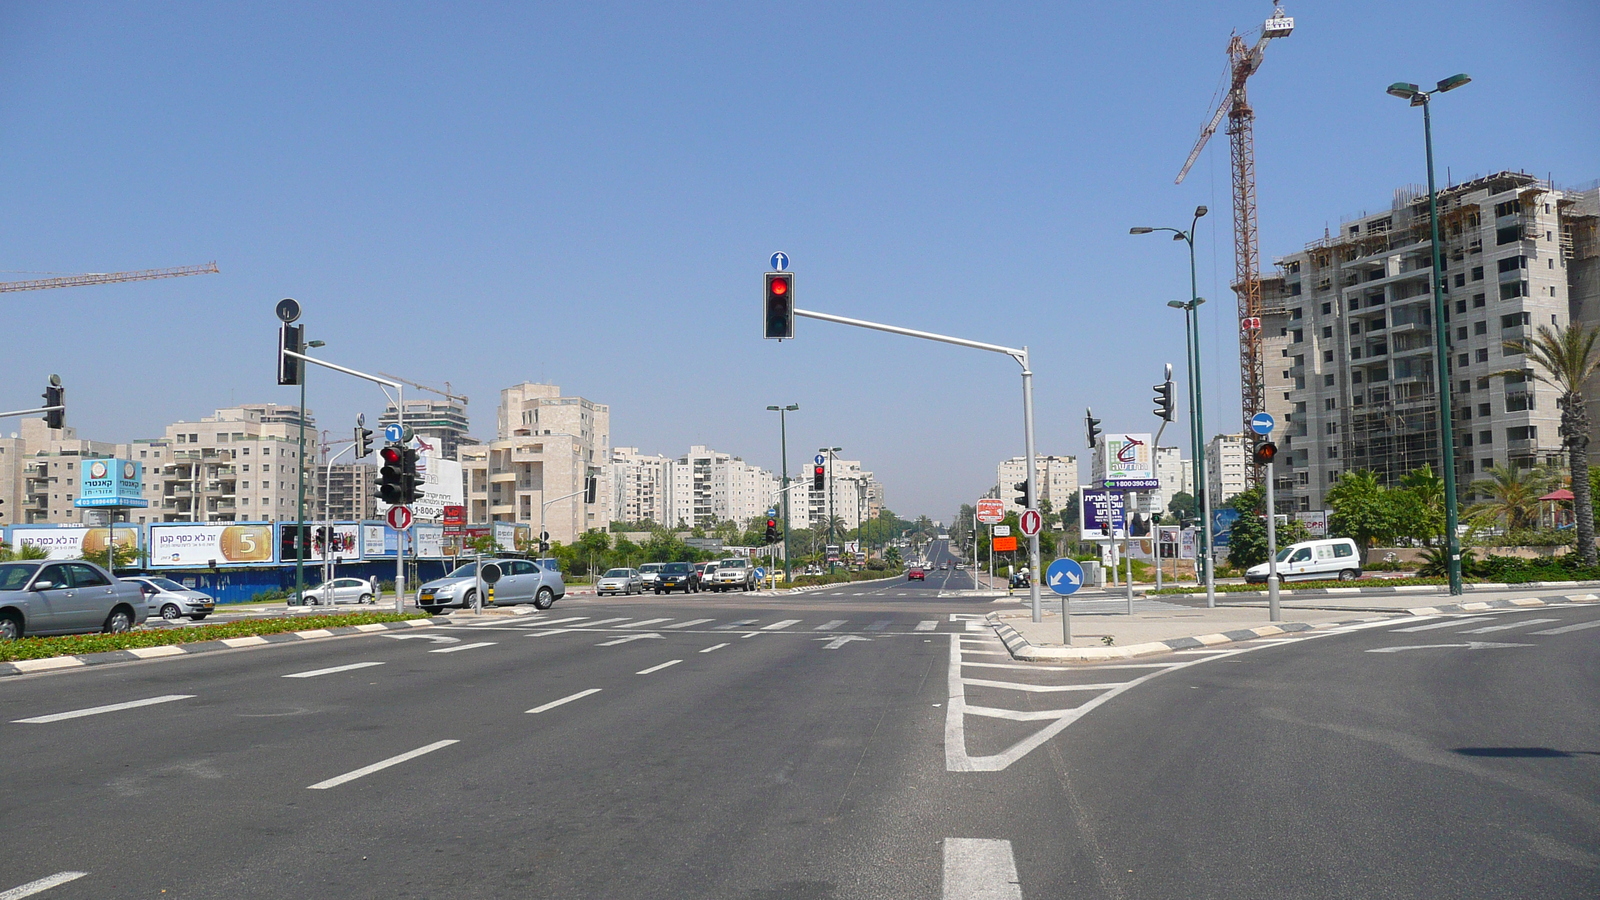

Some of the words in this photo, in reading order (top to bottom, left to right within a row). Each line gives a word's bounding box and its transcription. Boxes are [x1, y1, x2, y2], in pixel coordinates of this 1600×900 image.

[36, 537, 54, 546] כסף
[56, 535, 67, 544] לא
[160, 535, 174, 544] קטן
[176, 535, 192, 543] כסף
[194, 532, 206, 542] לא
[240, 533, 256, 553] 5
